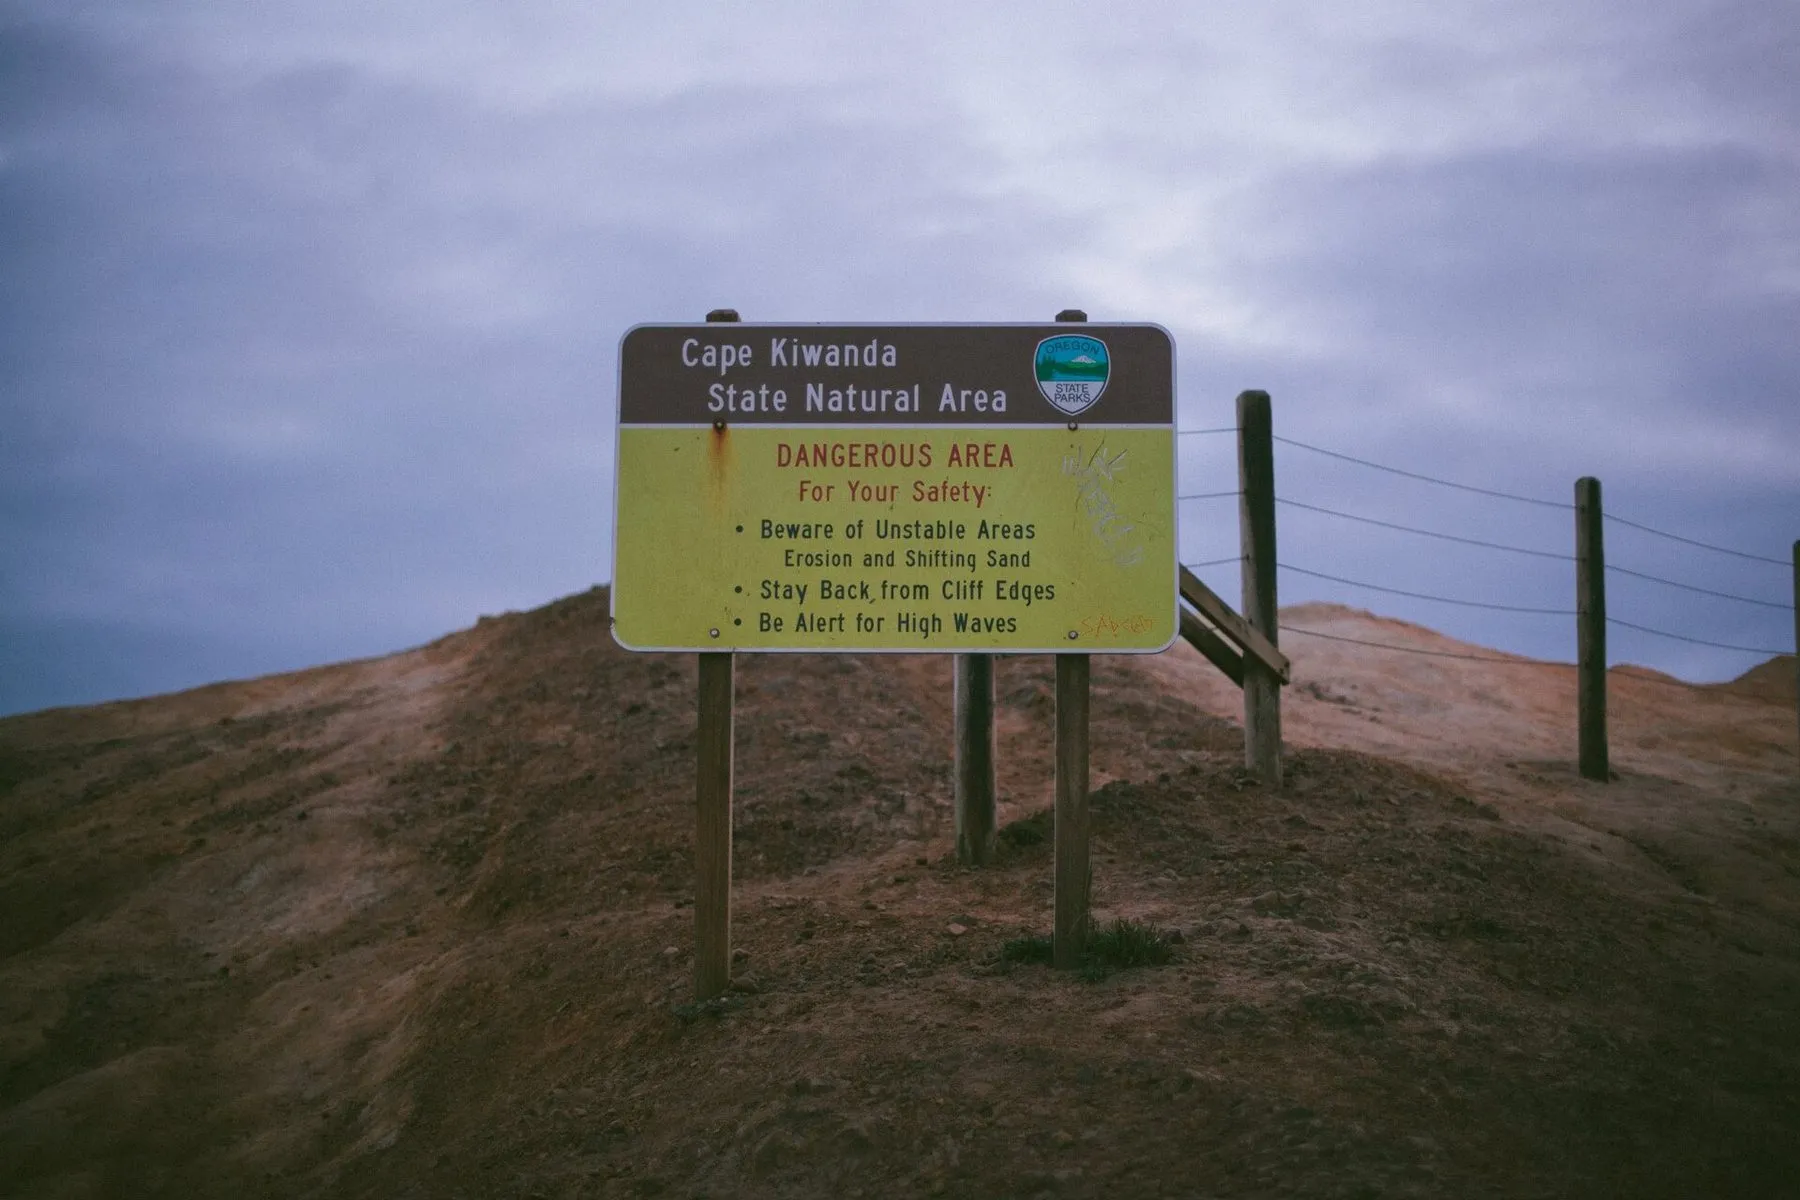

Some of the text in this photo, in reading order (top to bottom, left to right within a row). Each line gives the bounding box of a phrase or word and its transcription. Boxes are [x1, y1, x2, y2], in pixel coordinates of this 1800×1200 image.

[683, 337, 897, 376] Cape Kiwanda
[1045, 340, 1100, 355] OREGON
[707, 383, 1007, 413] State Natural Area
[1054, 393, 1091, 403] PARKS
[1055, 383, 1089, 393] STATE
[777, 443, 1014, 468] DANGEROUS AREA
[799, 480, 835, 503] For
[847, 480, 900, 503] Your
[760, 519, 1036, 540] Beware of Unstable Areas
[784, 549, 1030, 573] Erosion and Shifting Sand
[760, 579, 1056, 607] Stay Back from Cliff Edges
[759, 611, 1017, 640] Be Alert for High Waves
